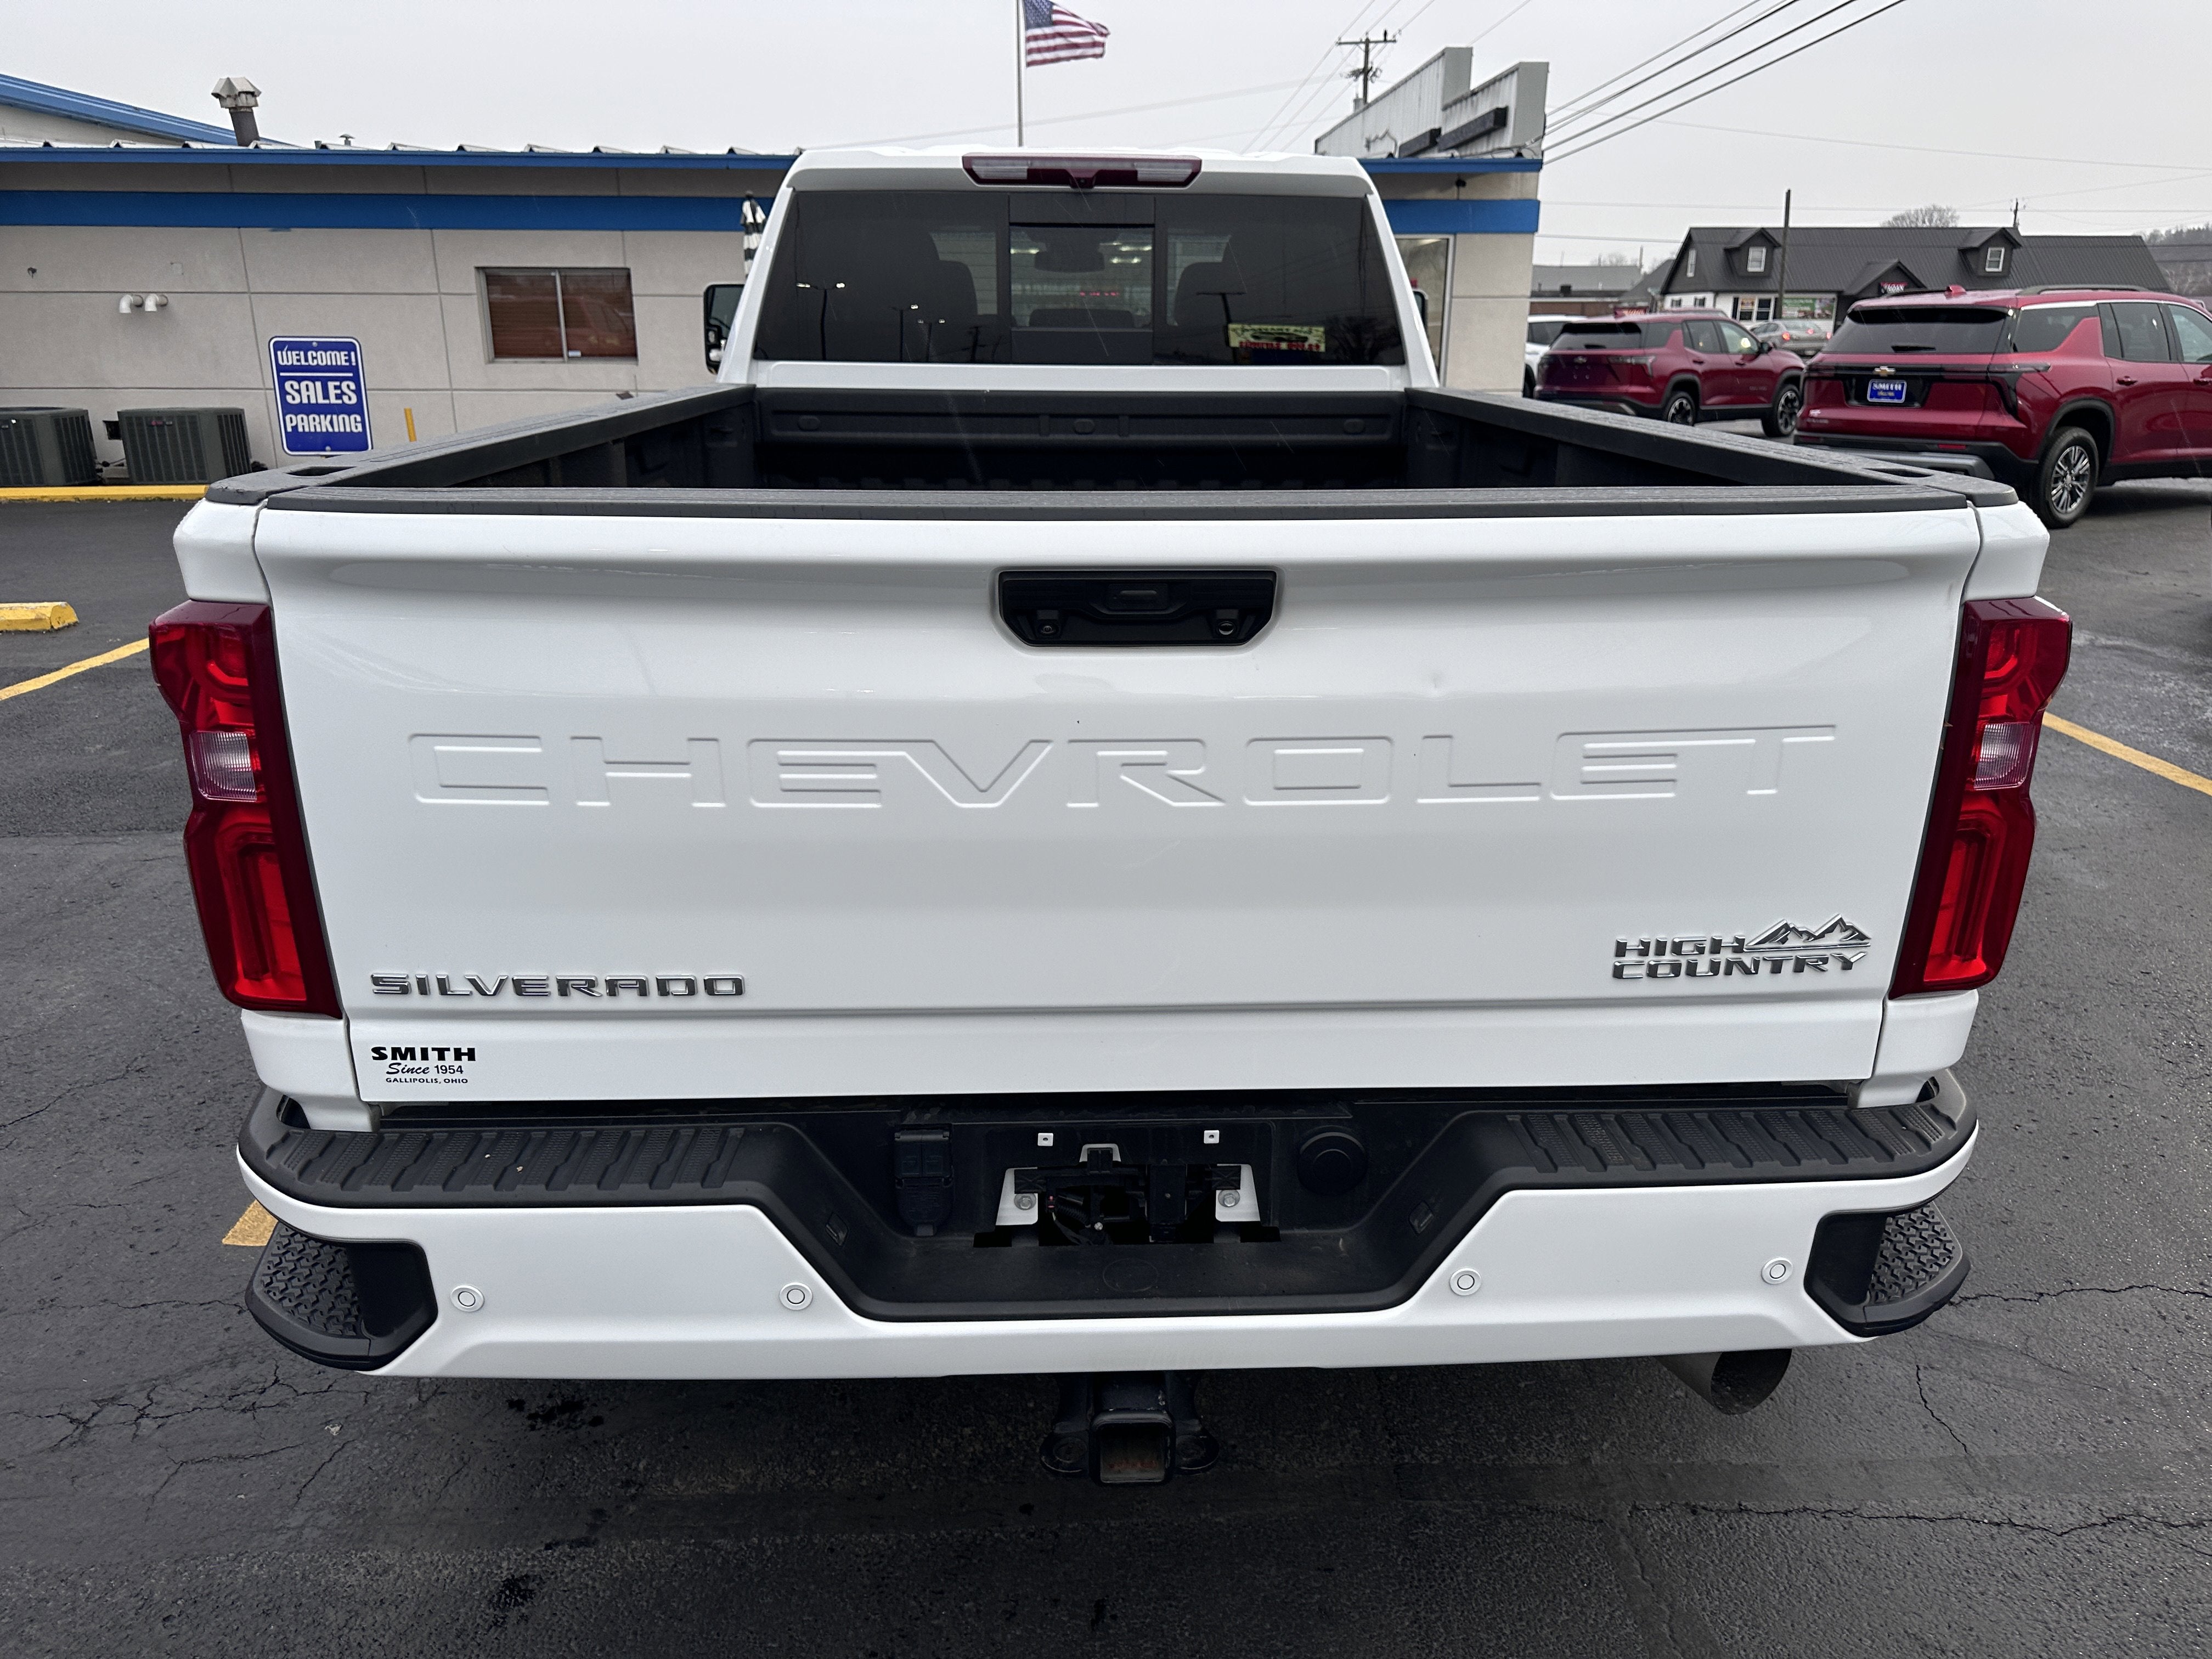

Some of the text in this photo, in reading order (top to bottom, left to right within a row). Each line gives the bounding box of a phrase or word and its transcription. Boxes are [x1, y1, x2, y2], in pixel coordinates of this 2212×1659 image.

[277, 346, 356, 366] WELCOME!
[284, 380, 357, 404] SALES
[285, 414, 363, 432] PARKING
[408, 724, 1837, 808] CHEVROLET
[1615, 934, 1746, 957] HIGH
[1613, 951, 1867, 979] COUNTRY
[370, 973, 746, 997] SILVERADO
[371, 1046, 476, 1062] SMITH
[386, 1062, 464, 1075] Since 1954
